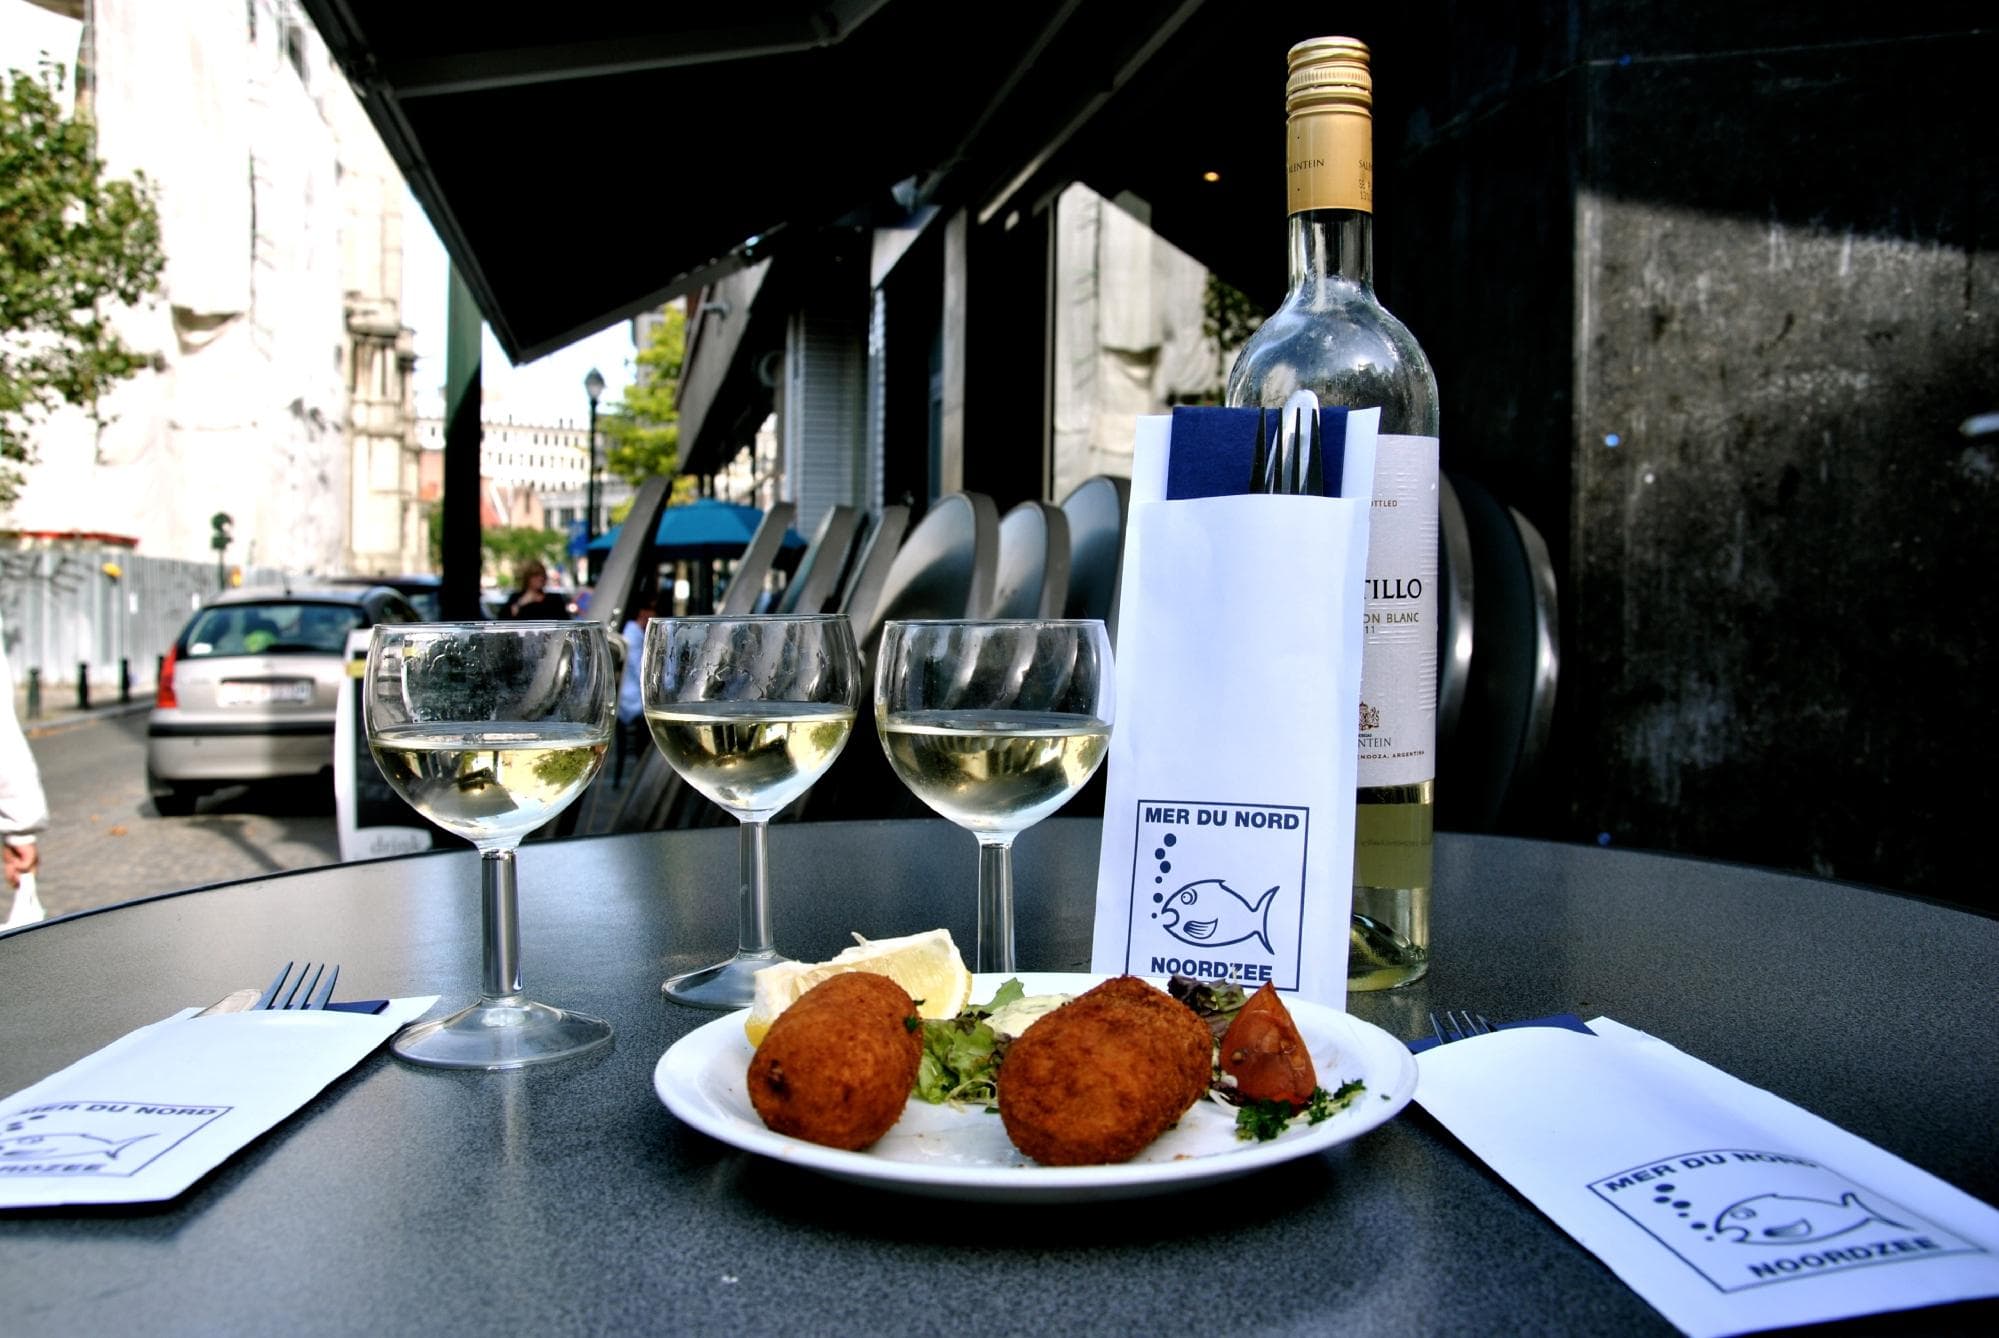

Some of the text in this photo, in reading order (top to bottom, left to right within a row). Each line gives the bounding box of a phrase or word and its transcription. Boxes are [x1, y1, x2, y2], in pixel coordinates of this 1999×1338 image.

[1371, 499, 1398, 508] TTLED
[1386, 612, 1419, 623] BLANC
[1145, 807, 1300, 830] MER DU NORD
[1151, 957, 1273, 981] NOORDZEE
[86, 1104, 130, 1113] DU
[134, 1105, 218, 1116] NORD
[1604, 1164, 1677, 1192] MER
[1680, 1153, 1728, 1169] DU
[1748, 1236, 1944, 1279] NOORDZEE
